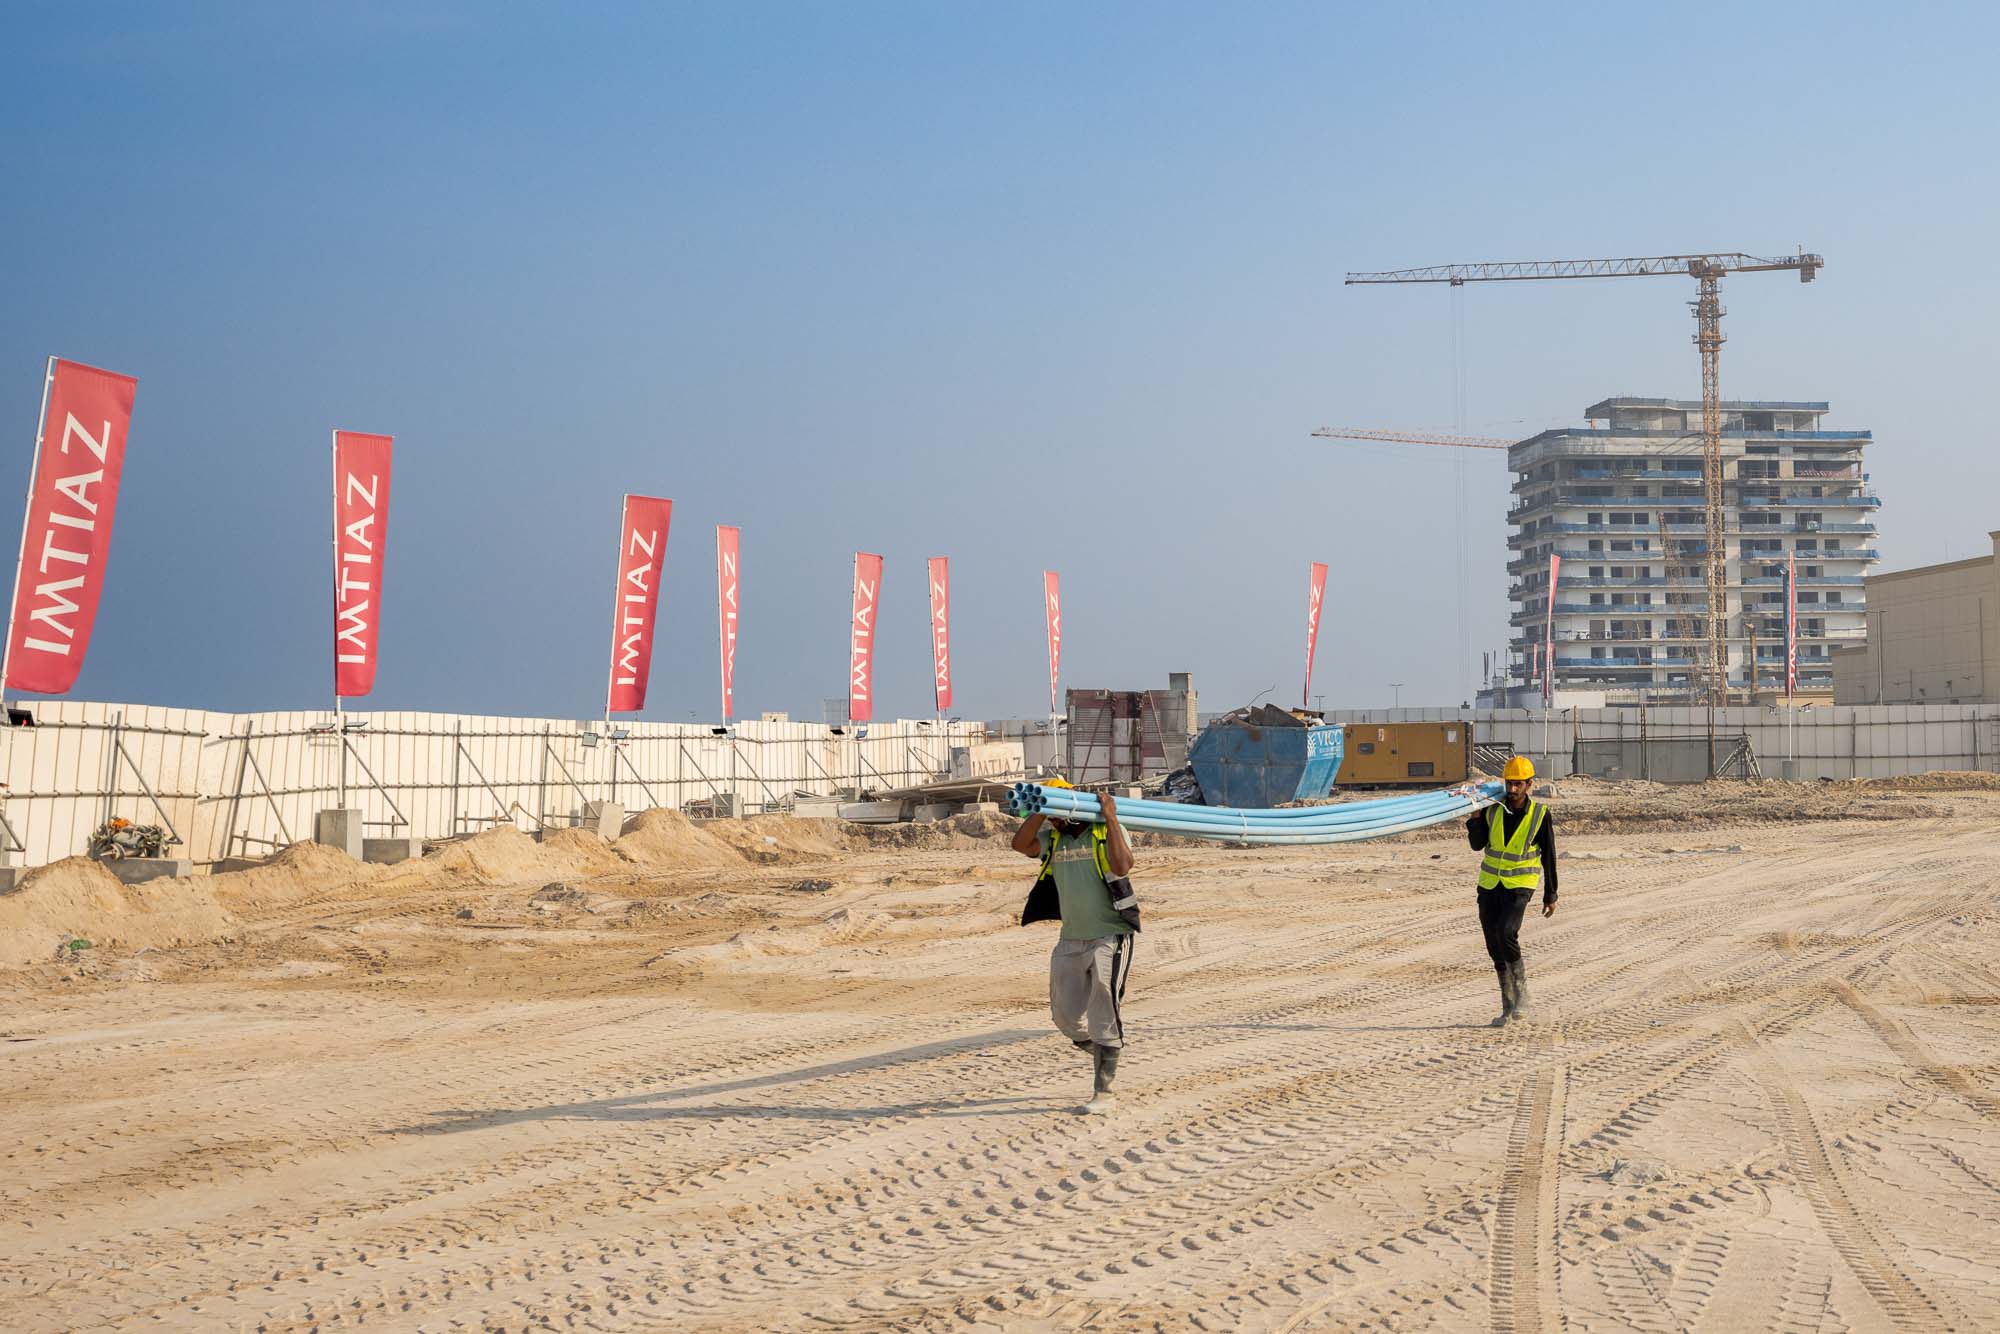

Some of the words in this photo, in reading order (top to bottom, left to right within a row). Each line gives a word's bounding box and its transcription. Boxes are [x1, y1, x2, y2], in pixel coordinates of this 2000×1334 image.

[24, 411, 111, 656] IMTIAZ
[338, 471, 378, 664] IMTIAZ
[617, 527, 657, 685] IMTIAZ
[724, 551, 737, 696] IMTIAZ
[852, 579, 875, 701] IMTIAZ
[932, 579, 949, 691] IMTIAZ
